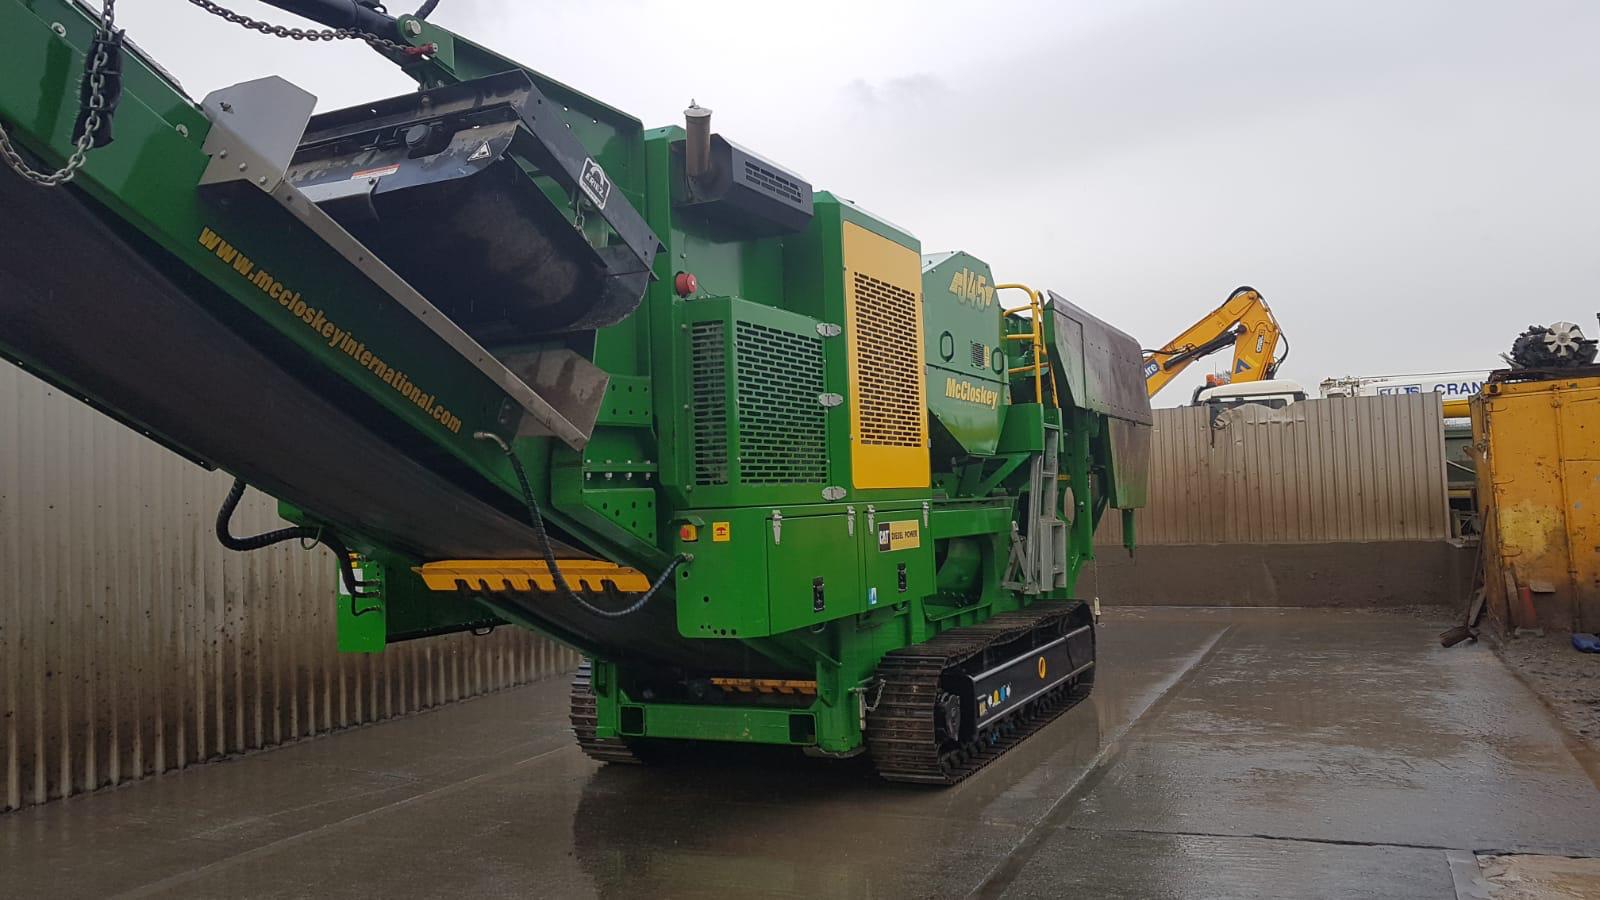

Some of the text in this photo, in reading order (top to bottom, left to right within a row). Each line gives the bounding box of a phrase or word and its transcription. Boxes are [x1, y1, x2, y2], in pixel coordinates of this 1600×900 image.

[198, 226, 462, 433] www.mccloskeyinternational.com
[1144, 363, 1159, 378] ire
[945, 377, 998, 410] McCloskey
[879, 529, 918, 545] CAT DIESEL POWER
